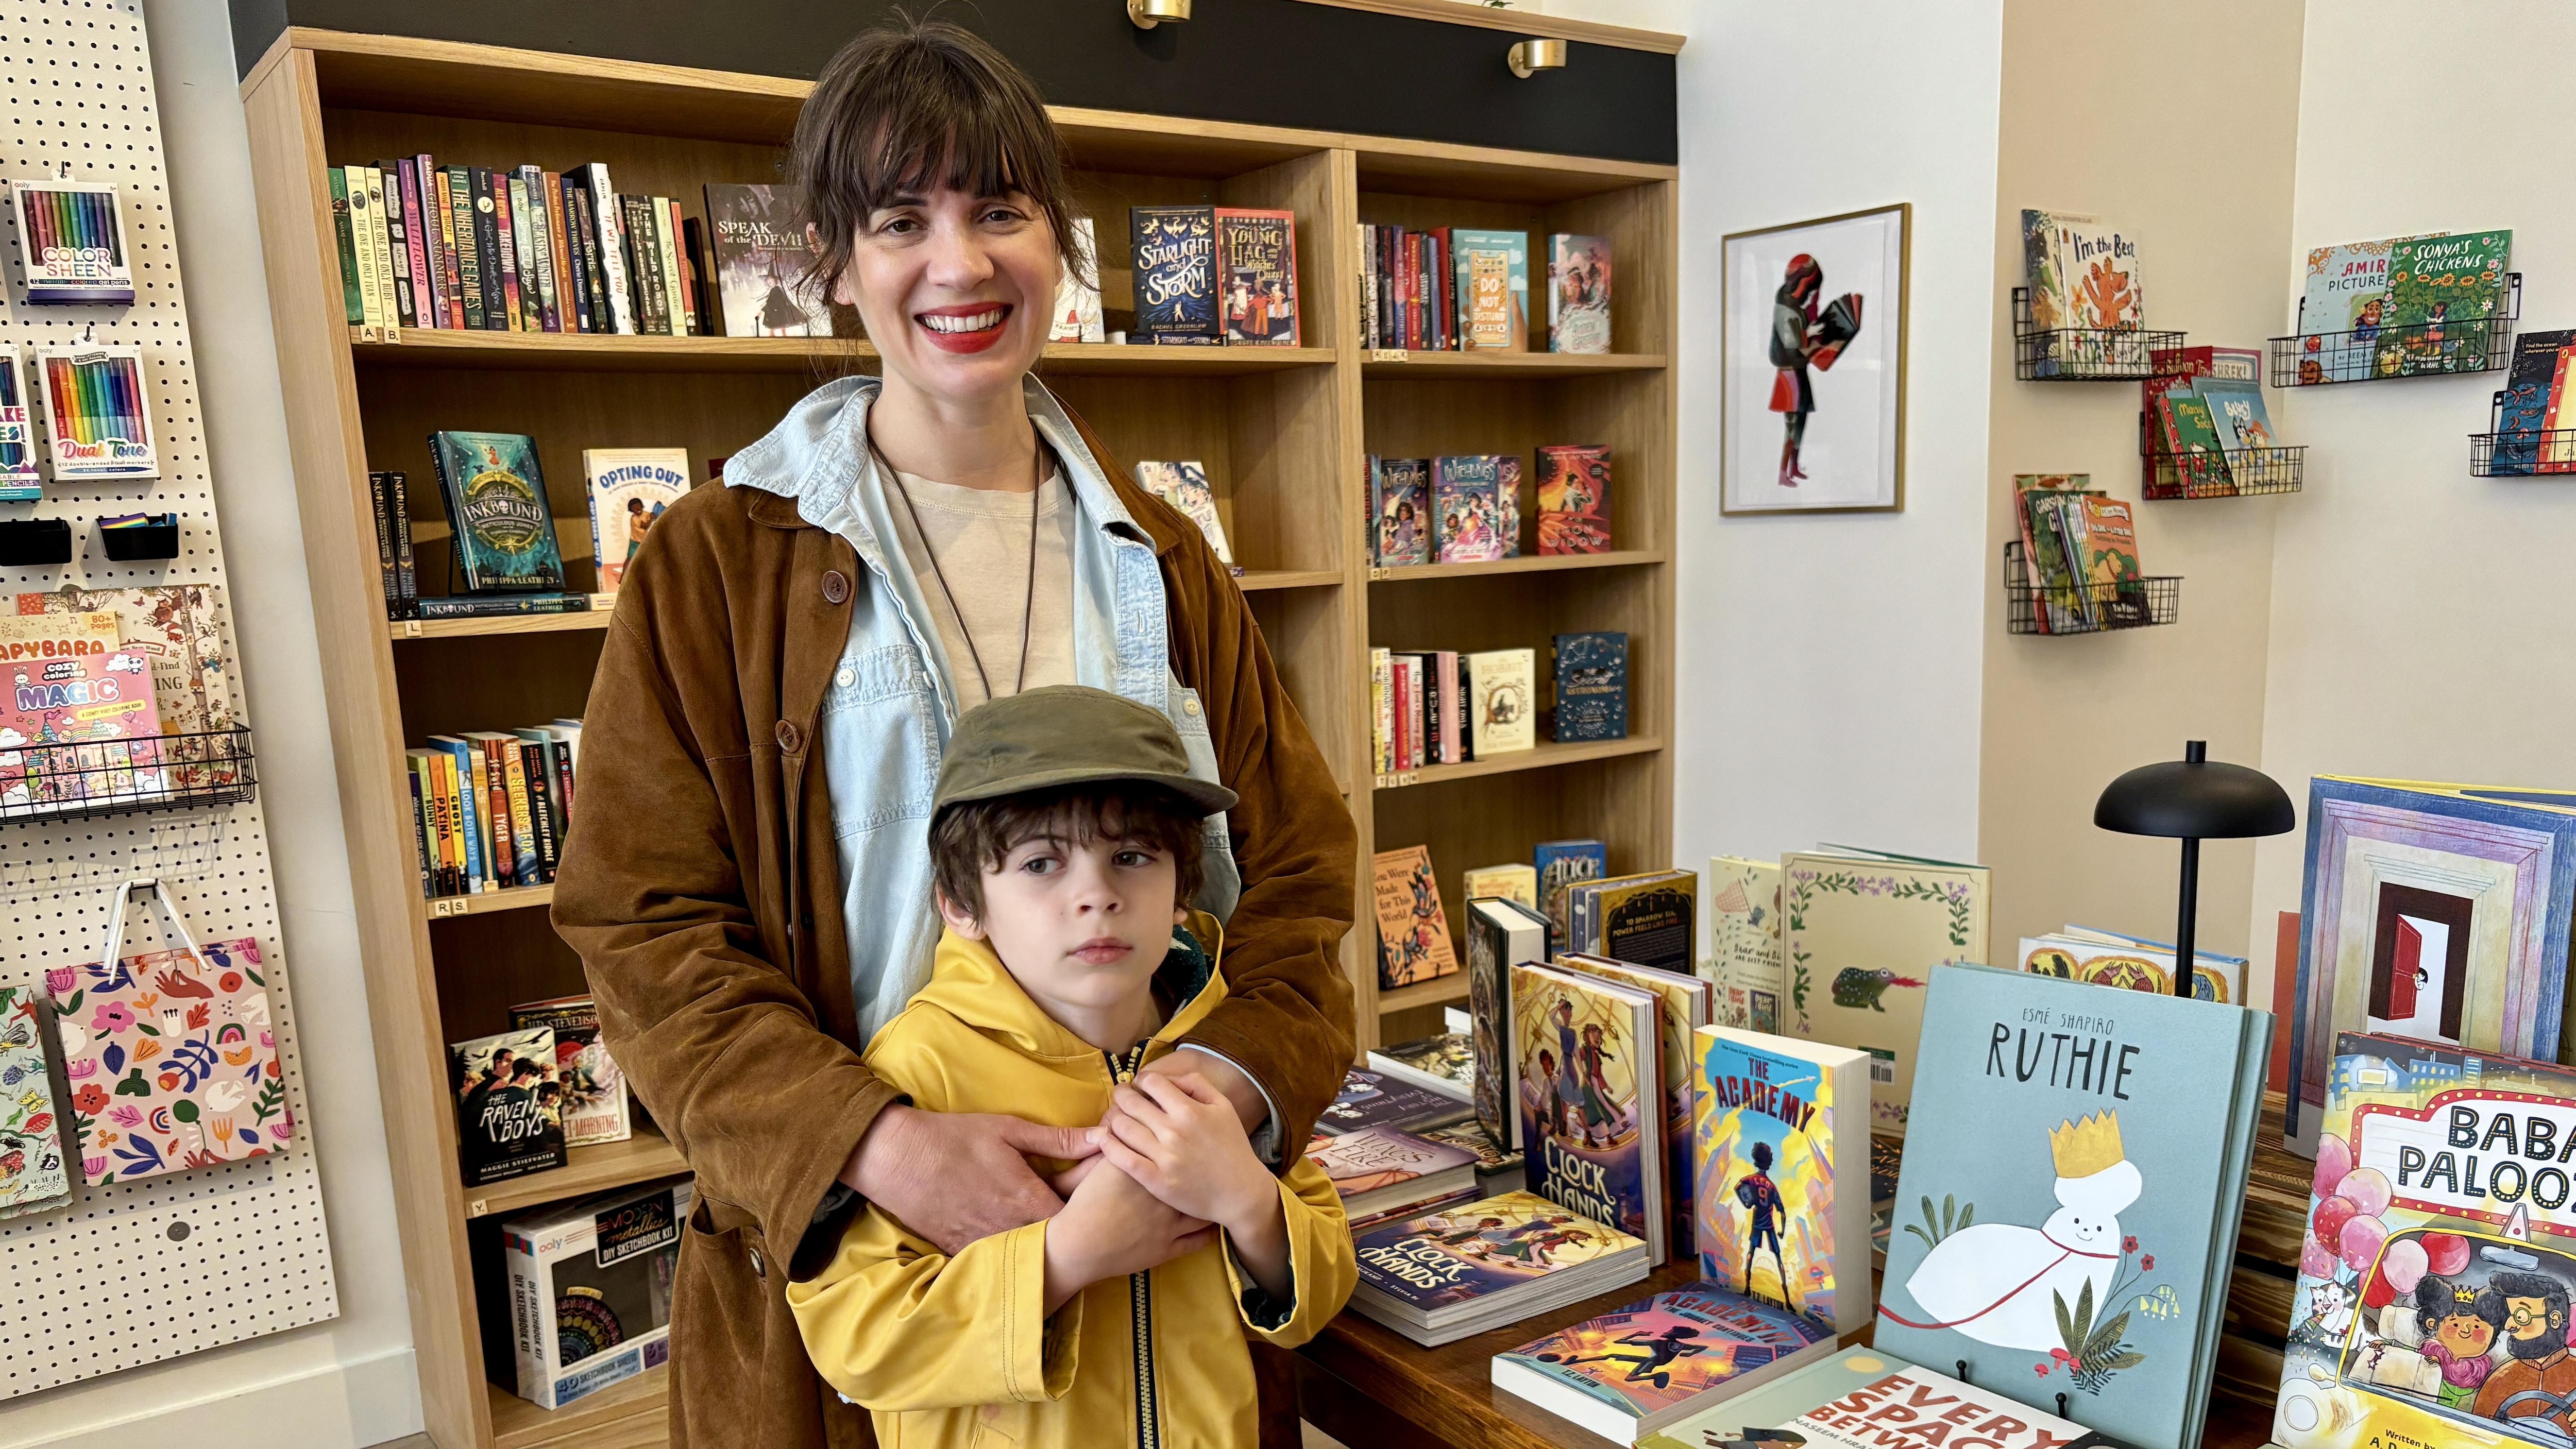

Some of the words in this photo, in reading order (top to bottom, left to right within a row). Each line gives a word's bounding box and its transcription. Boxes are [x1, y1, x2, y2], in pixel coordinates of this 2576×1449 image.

[424, 161, 434, 186] BADUA
[451, 186, 470, 210] THE
[357, 218, 366, 231] THE
[374, 216, 384, 230] THE
[426, 192, 440, 234] GHOUL
[567, 200, 577, 229] MARROW
[643, 213, 652, 236] THE
[442, 214, 452, 236] THIRST
[515, 215, 532, 245] Simon
[606, 229, 614, 242] WE
[718, 221, 772, 237] SPEAK
[359, 233, 368, 247] ONE
[376, 232, 386, 245] ONE
[406, 211, 426, 286] WALLFLOWER
[453, 208, 479, 274] INHERITANCE
[570, 230, 580, 255] THIEVES
[736, 235, 751, 244] the
[1226, 228, 1283, 250] YOUNG
[2073, 232, 2095, 262] I'm
[2096, 236, 2112, 253] the
[2114, 233, 2135, 259] Best
[44, 249, 110, 262] COLOR
[360, 248, 370, 261] AND
[378, 248, 388, 262] AND
[395, 247, 406, 272] always
[497, 228, 515, 274] TAKEDOWN
[609, 249, 619, 270] TELL
[646, 240, 658, 272] WILD
[1139, 238, 1212, 270] STARLIGHT
[1227, 245, 1266, 266] HAG
[2414, 240, 2472, 261] SONYA'S
[47, 264, 112, 277] SHEEN
[362, 263, 372, 280] ONLY
[379, 264, 391, 282] ONLY
[431, 237, 448, 290] SUMMER
[536, 257, 552, 288] WINTER
[1165, 261, 1185, 272] and
[2341, 259, 2385, 277] AMIR
[2414, 253, 2484, 275] CHICKENS
[364, 280, 375, 297] IVAN
[381, 282, 393, 302] RUBY
[461, 272, 483, 311] GAMES
[520, 268, 537, 295] Says
[576, 278, 585, 303] Dimaline
[614, 276, 623, 294] YOU
[1146, 259, 1208, 305] STORM
[1480, 277, 1500, 293] DO
[2328, 275, 2384, 292] PICTURE
[652, 275, 664, 315] ROBOT
[1479, 297, 1500, 308] NOT
[58, 441, 106, 459] Dual
[108, 441, 148, 458] Tone
[599, 465, 653, 489] OPTING
[655, 467, 683, 487] OUT
[91, 615, 112, 624] 80+
[91, 622, 115, 630] pages
[43, 669, 86, 680] coloring
[47, 662, 79, 672] cozy
[18, 679, 118, 710] MAGIC
[462, 789, 472, 812] LOOK
[511, 777, 531, 824] SEEKERS
[425, 799, 435, 827] SUNNY
[435, 797, 450, 841] PATINA
[450, 795, 462, 833] GHOST
[537, 800, 550, 837] BLETCHLEY
[465, 815, 476, 837] BOTH
[493, 813, 509, 842] TYGER
[467, 840, 478, 861] WAYS
[520, 833, 535, 854] FOX
[543, 838, 554, 862] RIDDLE
[1382, 910, 1407, 922] World
[2022, 1008, 2050, 1025] ESMÉ
[2061, 1013, 2114, 1035] SHAPIRO
[1748, 1057, 1769, 1080] THE
[1986, 1022, 2140, 1101] RUTHIE
[488, 1093, 507, 1105] THE
[1715, 1075, 1816, 1133] ACADEMY
[479, 1088, 539, 1143] RAVEN
[499, 1106, 546, 1143] BOYS
[575, 1114, 617, 1136] MORNING
[1330, 1143, 1398, 1167] FIRE
[1354, 1132, 1434, 1164] WINGS
[1545, 1136, 1616, 1205] CLOCK
[1541, 1174, 1614, 1229] HANDS
[1758, 1187, 1769, 1206] 9
[539, 1238, 562, 1253] ooly
[603, 1249, 615, 1262] DIY
[618, 1233, 661, 1256] SKETCHBOOK
[662, 1225, 673, 1238] KIT
[1359, 1247, 1446, 1288] HANDS
[1394, 1238, 1475, 1282] CLOCK
[514, 1274, 523, 1287] DIY
[1391, 1285, 1410, 1297] SYLVIA
[516, 1288, 529, 1339] SKETCHBOOK
[1662, 1293, 1777, 1333] ACADEMY
[1663, 1306, 1679, 1314] THE
[1713, 1324, 1756, 1342] CONTINUES
[521, 1339, 530, 1353] KIT
[1572, 1372, 1601, 1388] LAYTON
[1791, 1418, 1840, 1440] NASEEM
[2385, 1428, 2421, 1448] Written
